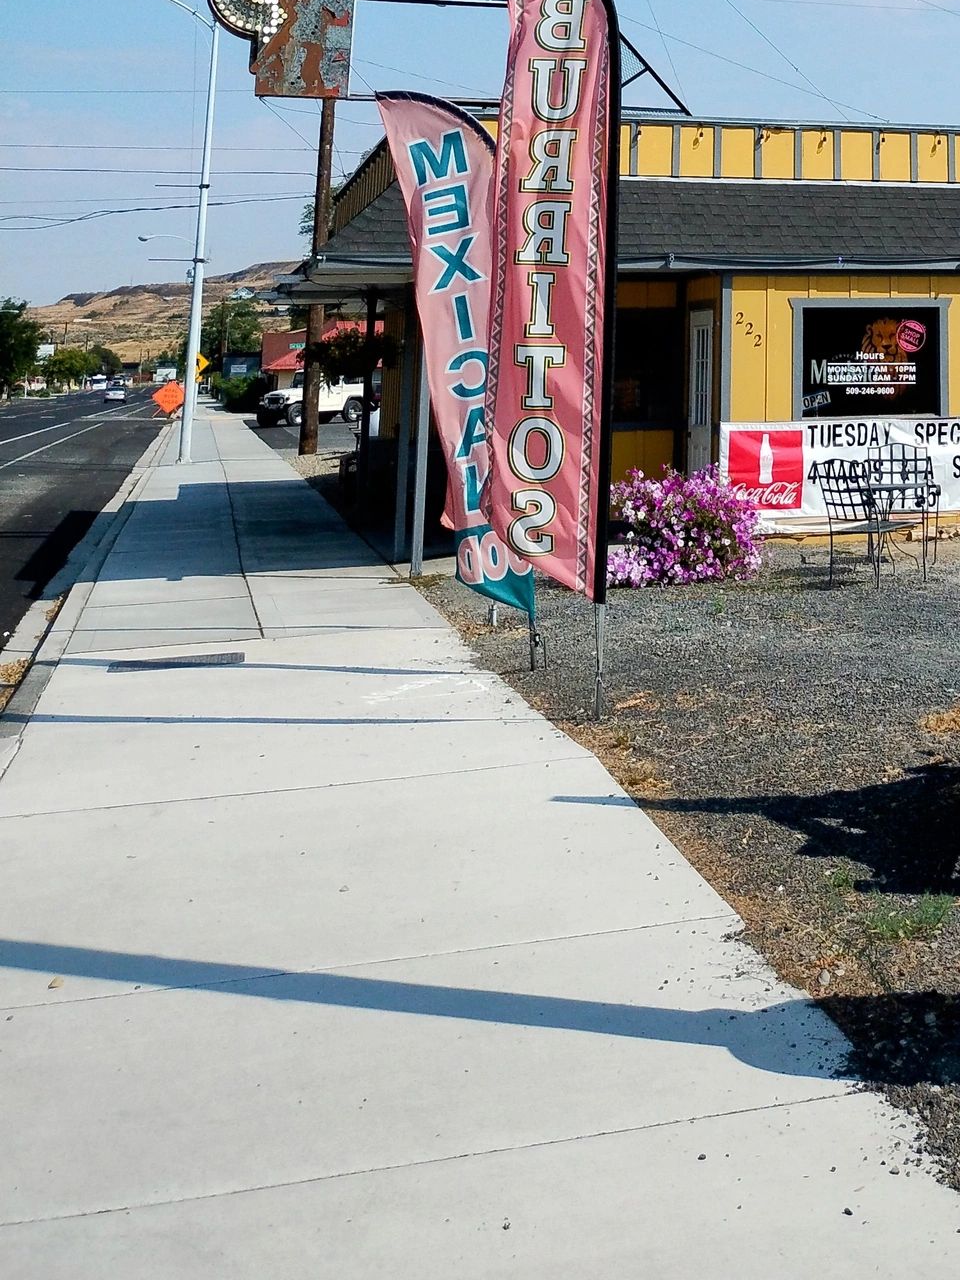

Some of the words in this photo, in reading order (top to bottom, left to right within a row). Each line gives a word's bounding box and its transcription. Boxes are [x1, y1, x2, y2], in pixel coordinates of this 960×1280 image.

[856, 351, 885, 360] Hours
[870, 365, 888, 373] 7AM
[895, 365, 917, 373] 10PM
[827, 374, 864, 382] SUNDAY
[807, 422, 892, 449] TUESDAY
